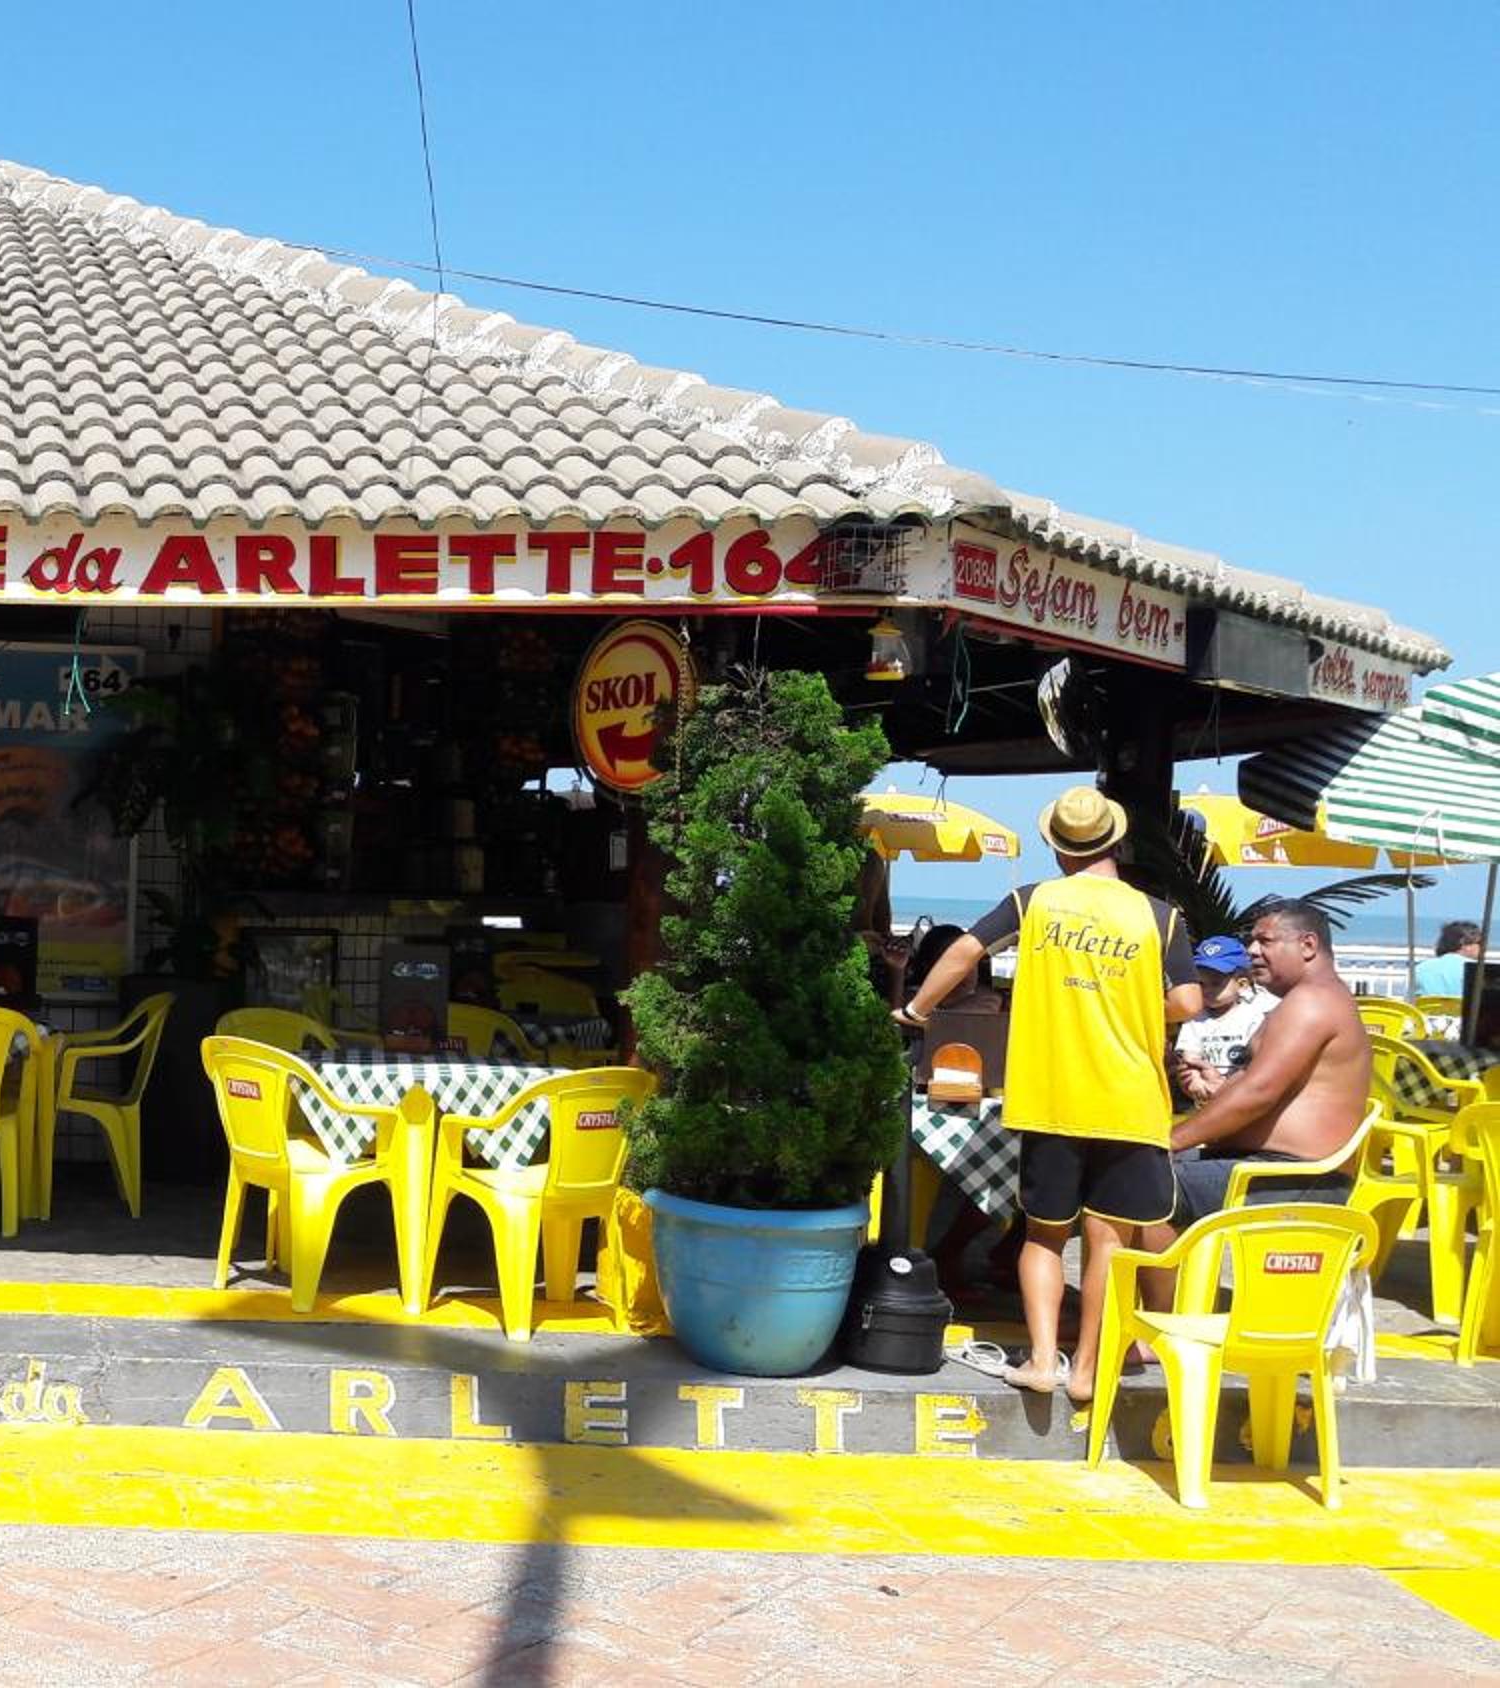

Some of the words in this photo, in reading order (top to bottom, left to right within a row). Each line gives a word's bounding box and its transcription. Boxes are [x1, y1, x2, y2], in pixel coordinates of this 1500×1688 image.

[21, 533, 122, 594] da
[1000, 543, 1098, 630] Sejam
[586, 672, 658, 714] SKOL
[1035, 921, 1141, 960] Arlette
[1265, 1255, 1318, 1271] CRYSTAL
[183, 1367, 980, 1457] ARLETTE
